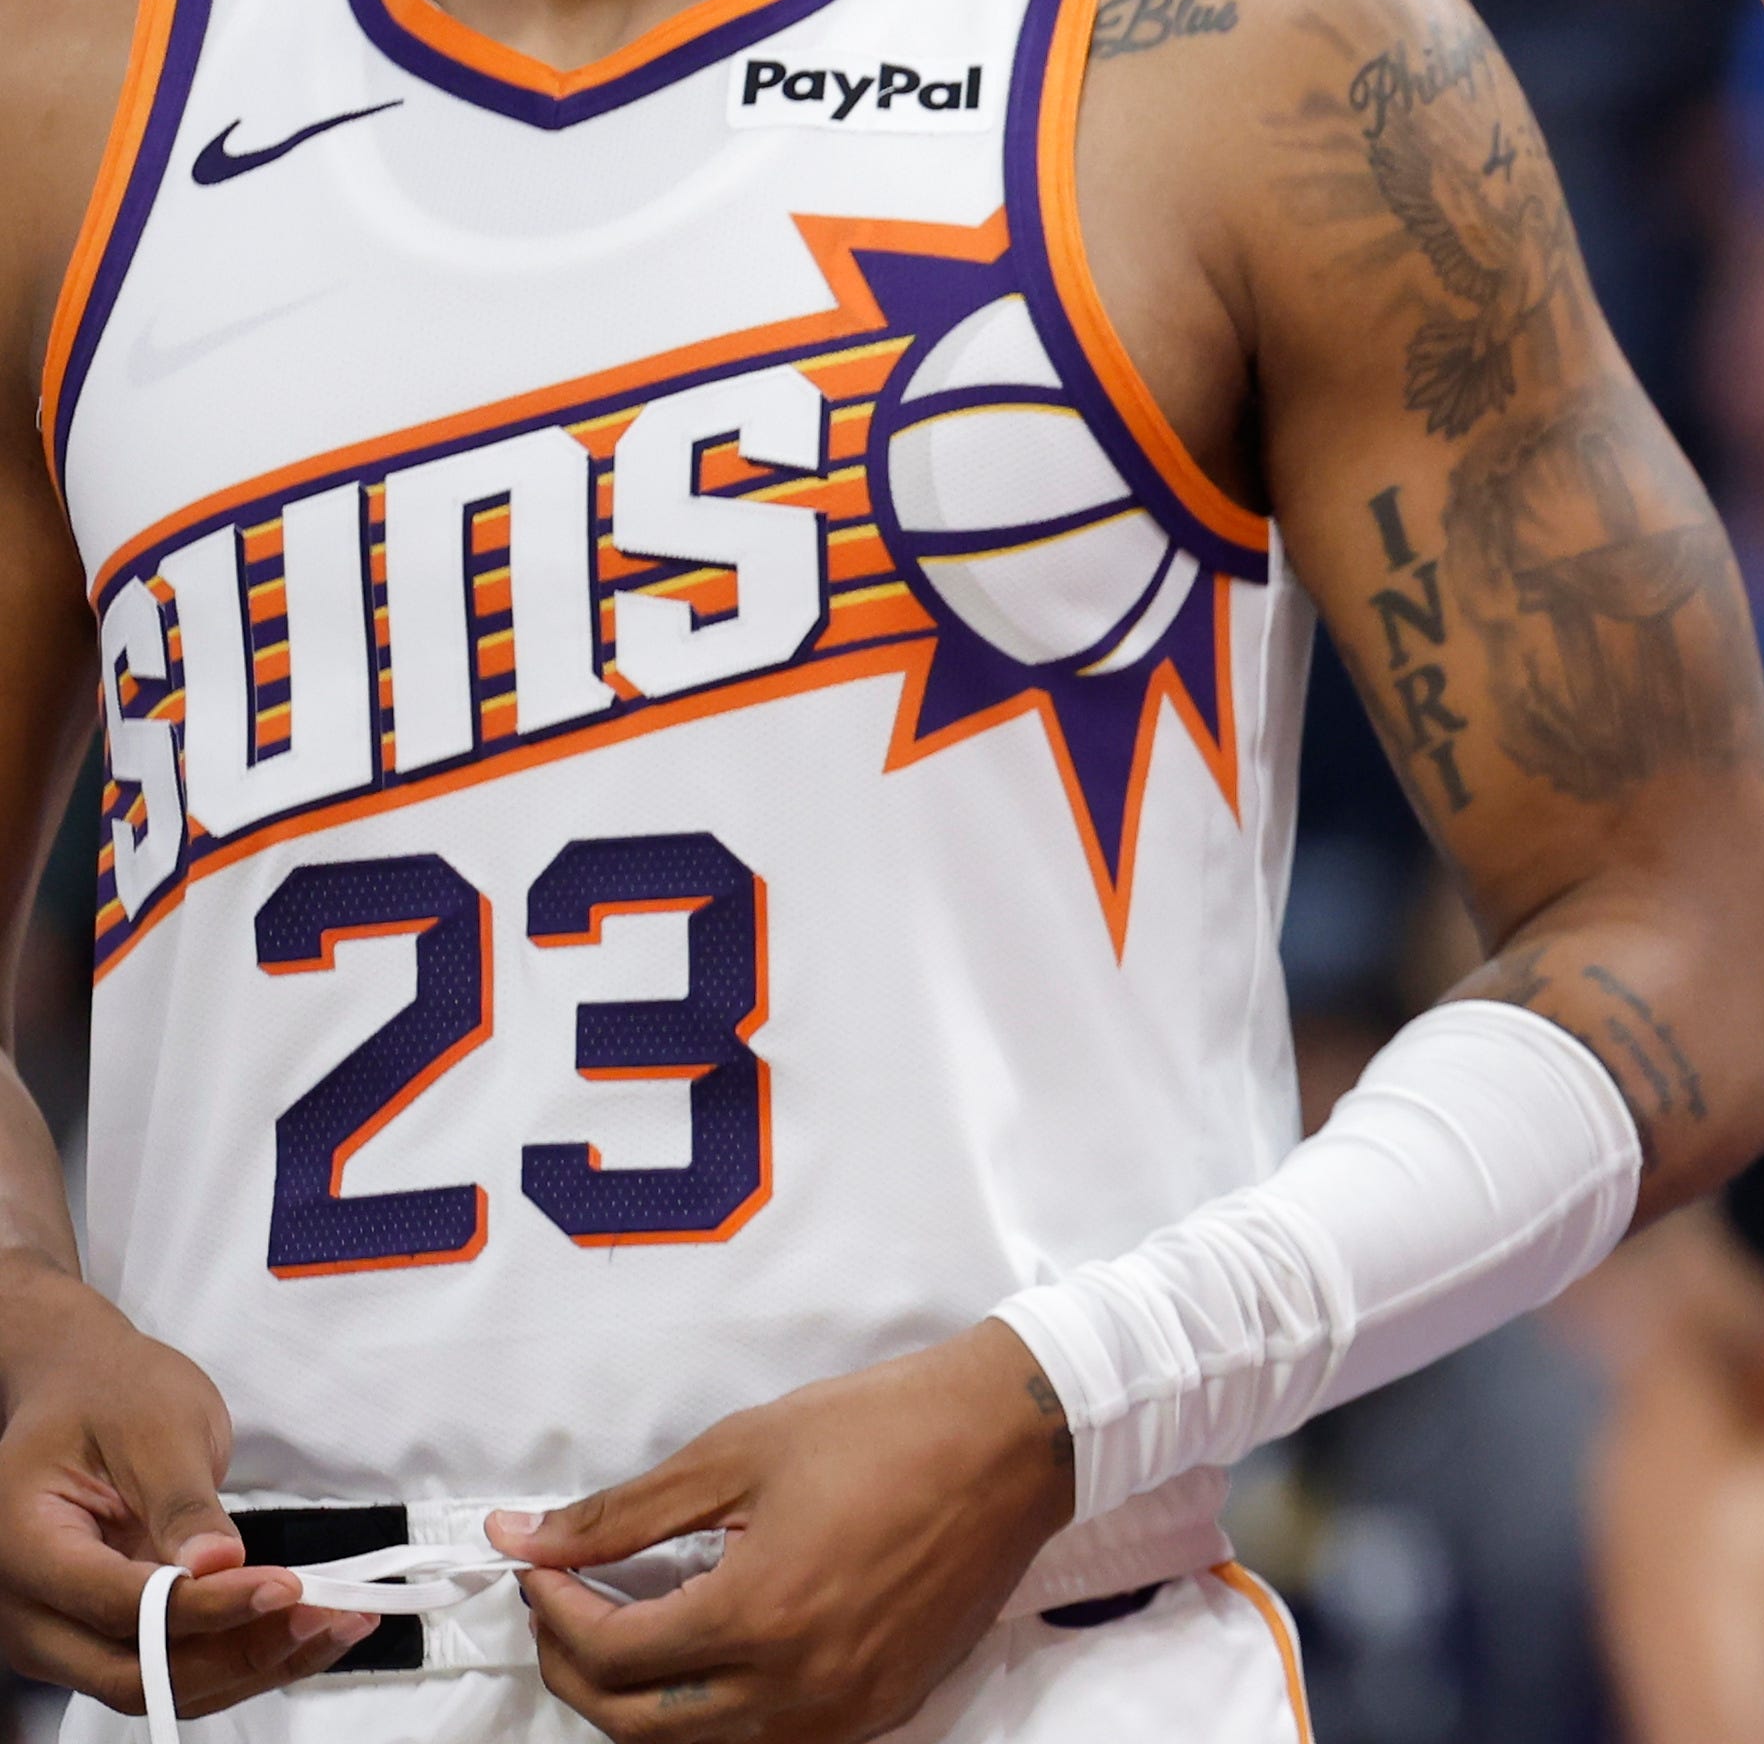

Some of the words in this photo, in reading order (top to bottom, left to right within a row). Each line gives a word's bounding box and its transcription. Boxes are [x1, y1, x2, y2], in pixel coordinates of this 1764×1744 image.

[742, 60, 982, 121] PayPal
[101, 364, 822, 922] SUNS
[1367, 483, 1475, 814] INRI
[253, 831, 774, 1281] 23
